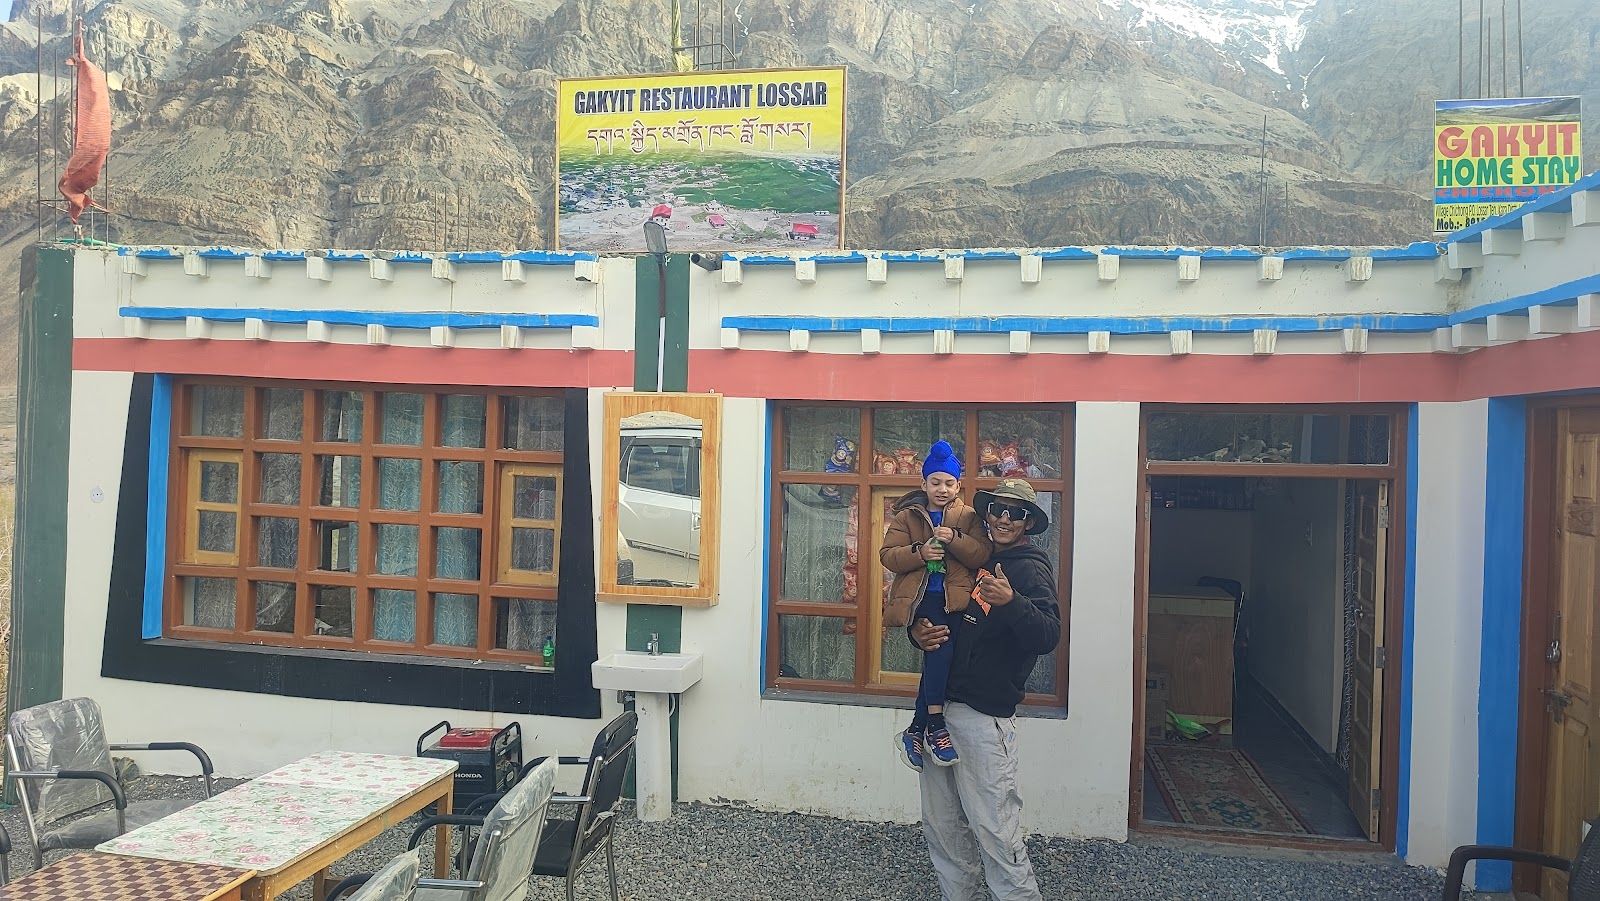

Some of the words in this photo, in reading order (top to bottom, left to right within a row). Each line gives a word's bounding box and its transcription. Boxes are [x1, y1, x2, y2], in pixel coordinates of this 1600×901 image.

[574, 89, 636, 114] GAKYIT
[639, 84, 753, 112] RESTAURANT
[757, 81, 827, 107] LOSSAR
[1437, 124, 1578, 158] GAKYIT
[1437, 157, 1514, 187] HOME
[1522, 156, 1580, 184] STAY
